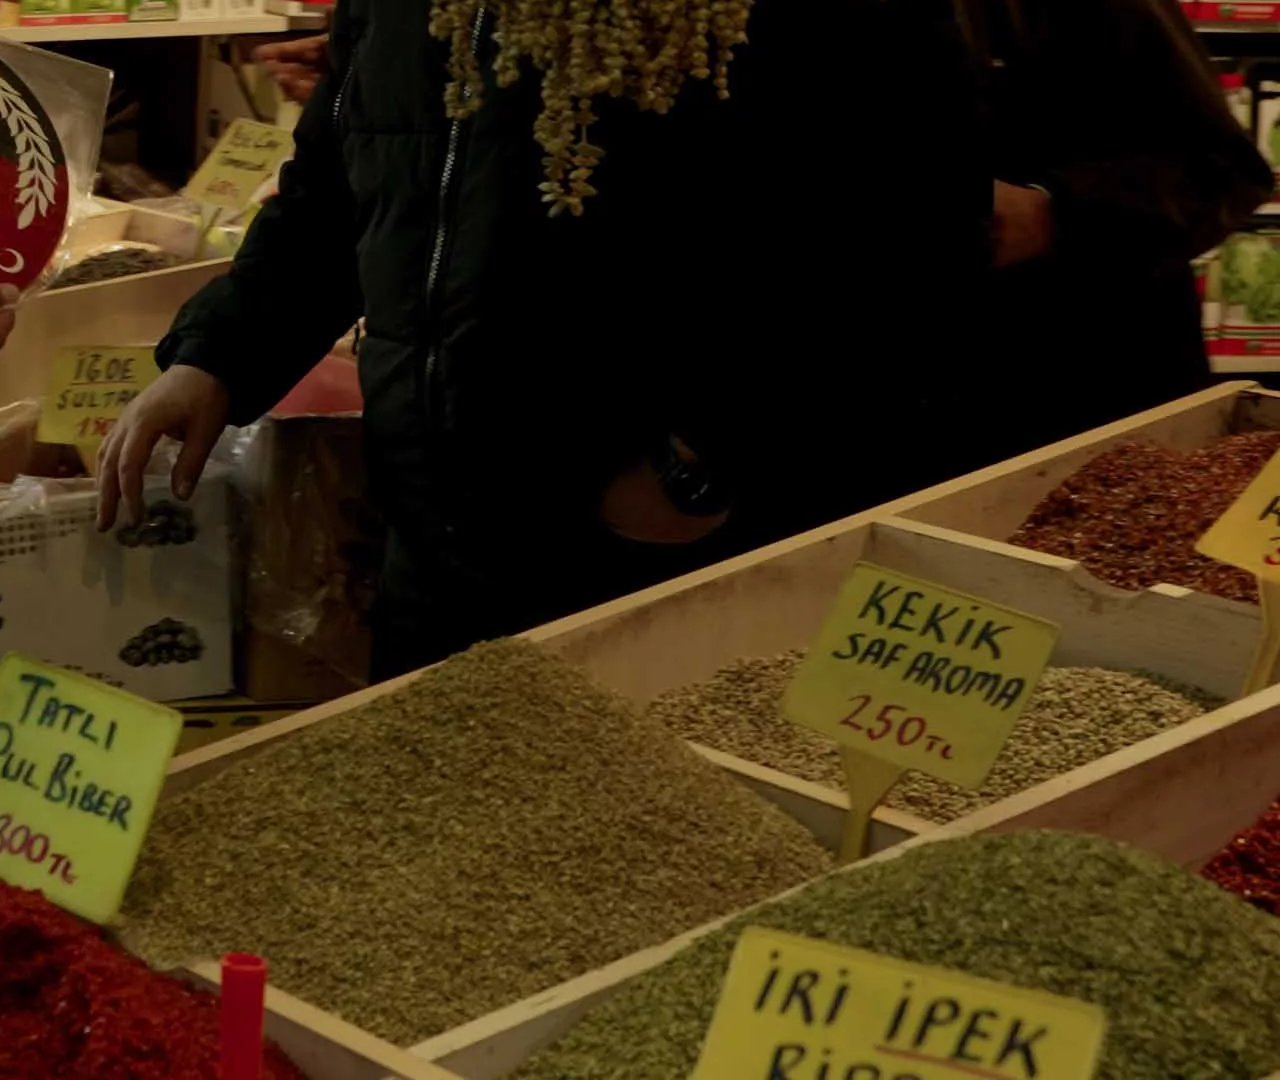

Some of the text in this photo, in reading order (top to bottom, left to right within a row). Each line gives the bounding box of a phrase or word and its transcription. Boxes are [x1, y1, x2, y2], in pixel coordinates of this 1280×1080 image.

[56, 389, 141, 411] SULTA
[858, 580, 1014, 660] KEKİK
[832, 633, 1025, 711] SAF AROMA
[754, 949, 1048, 1079] İRİ İPEK
